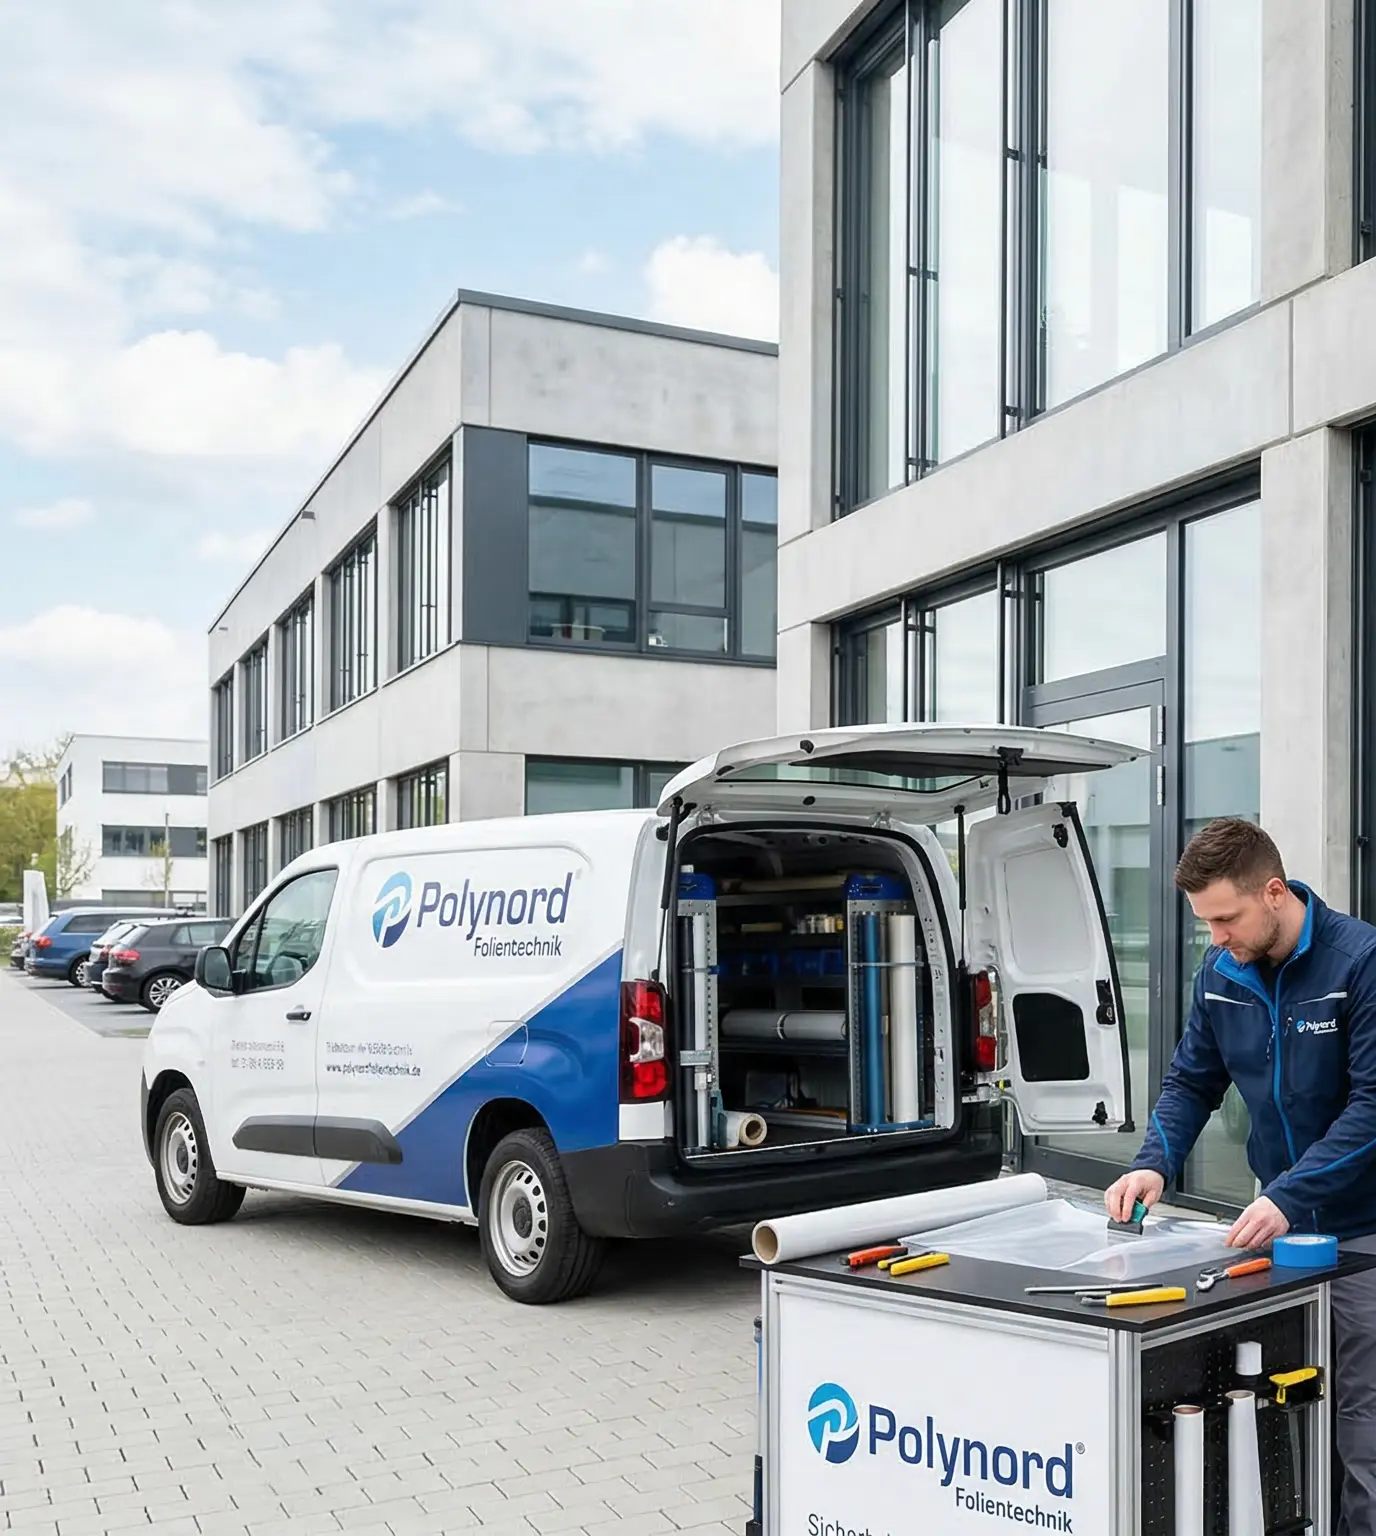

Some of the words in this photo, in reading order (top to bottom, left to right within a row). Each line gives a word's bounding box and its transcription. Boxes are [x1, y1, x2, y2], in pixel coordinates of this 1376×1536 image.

[417, 872, 573, 940] Polynord
[474, 935, 563, 957] Folientechnik
[956, 1487, 1074, 1534] Folientechnik
